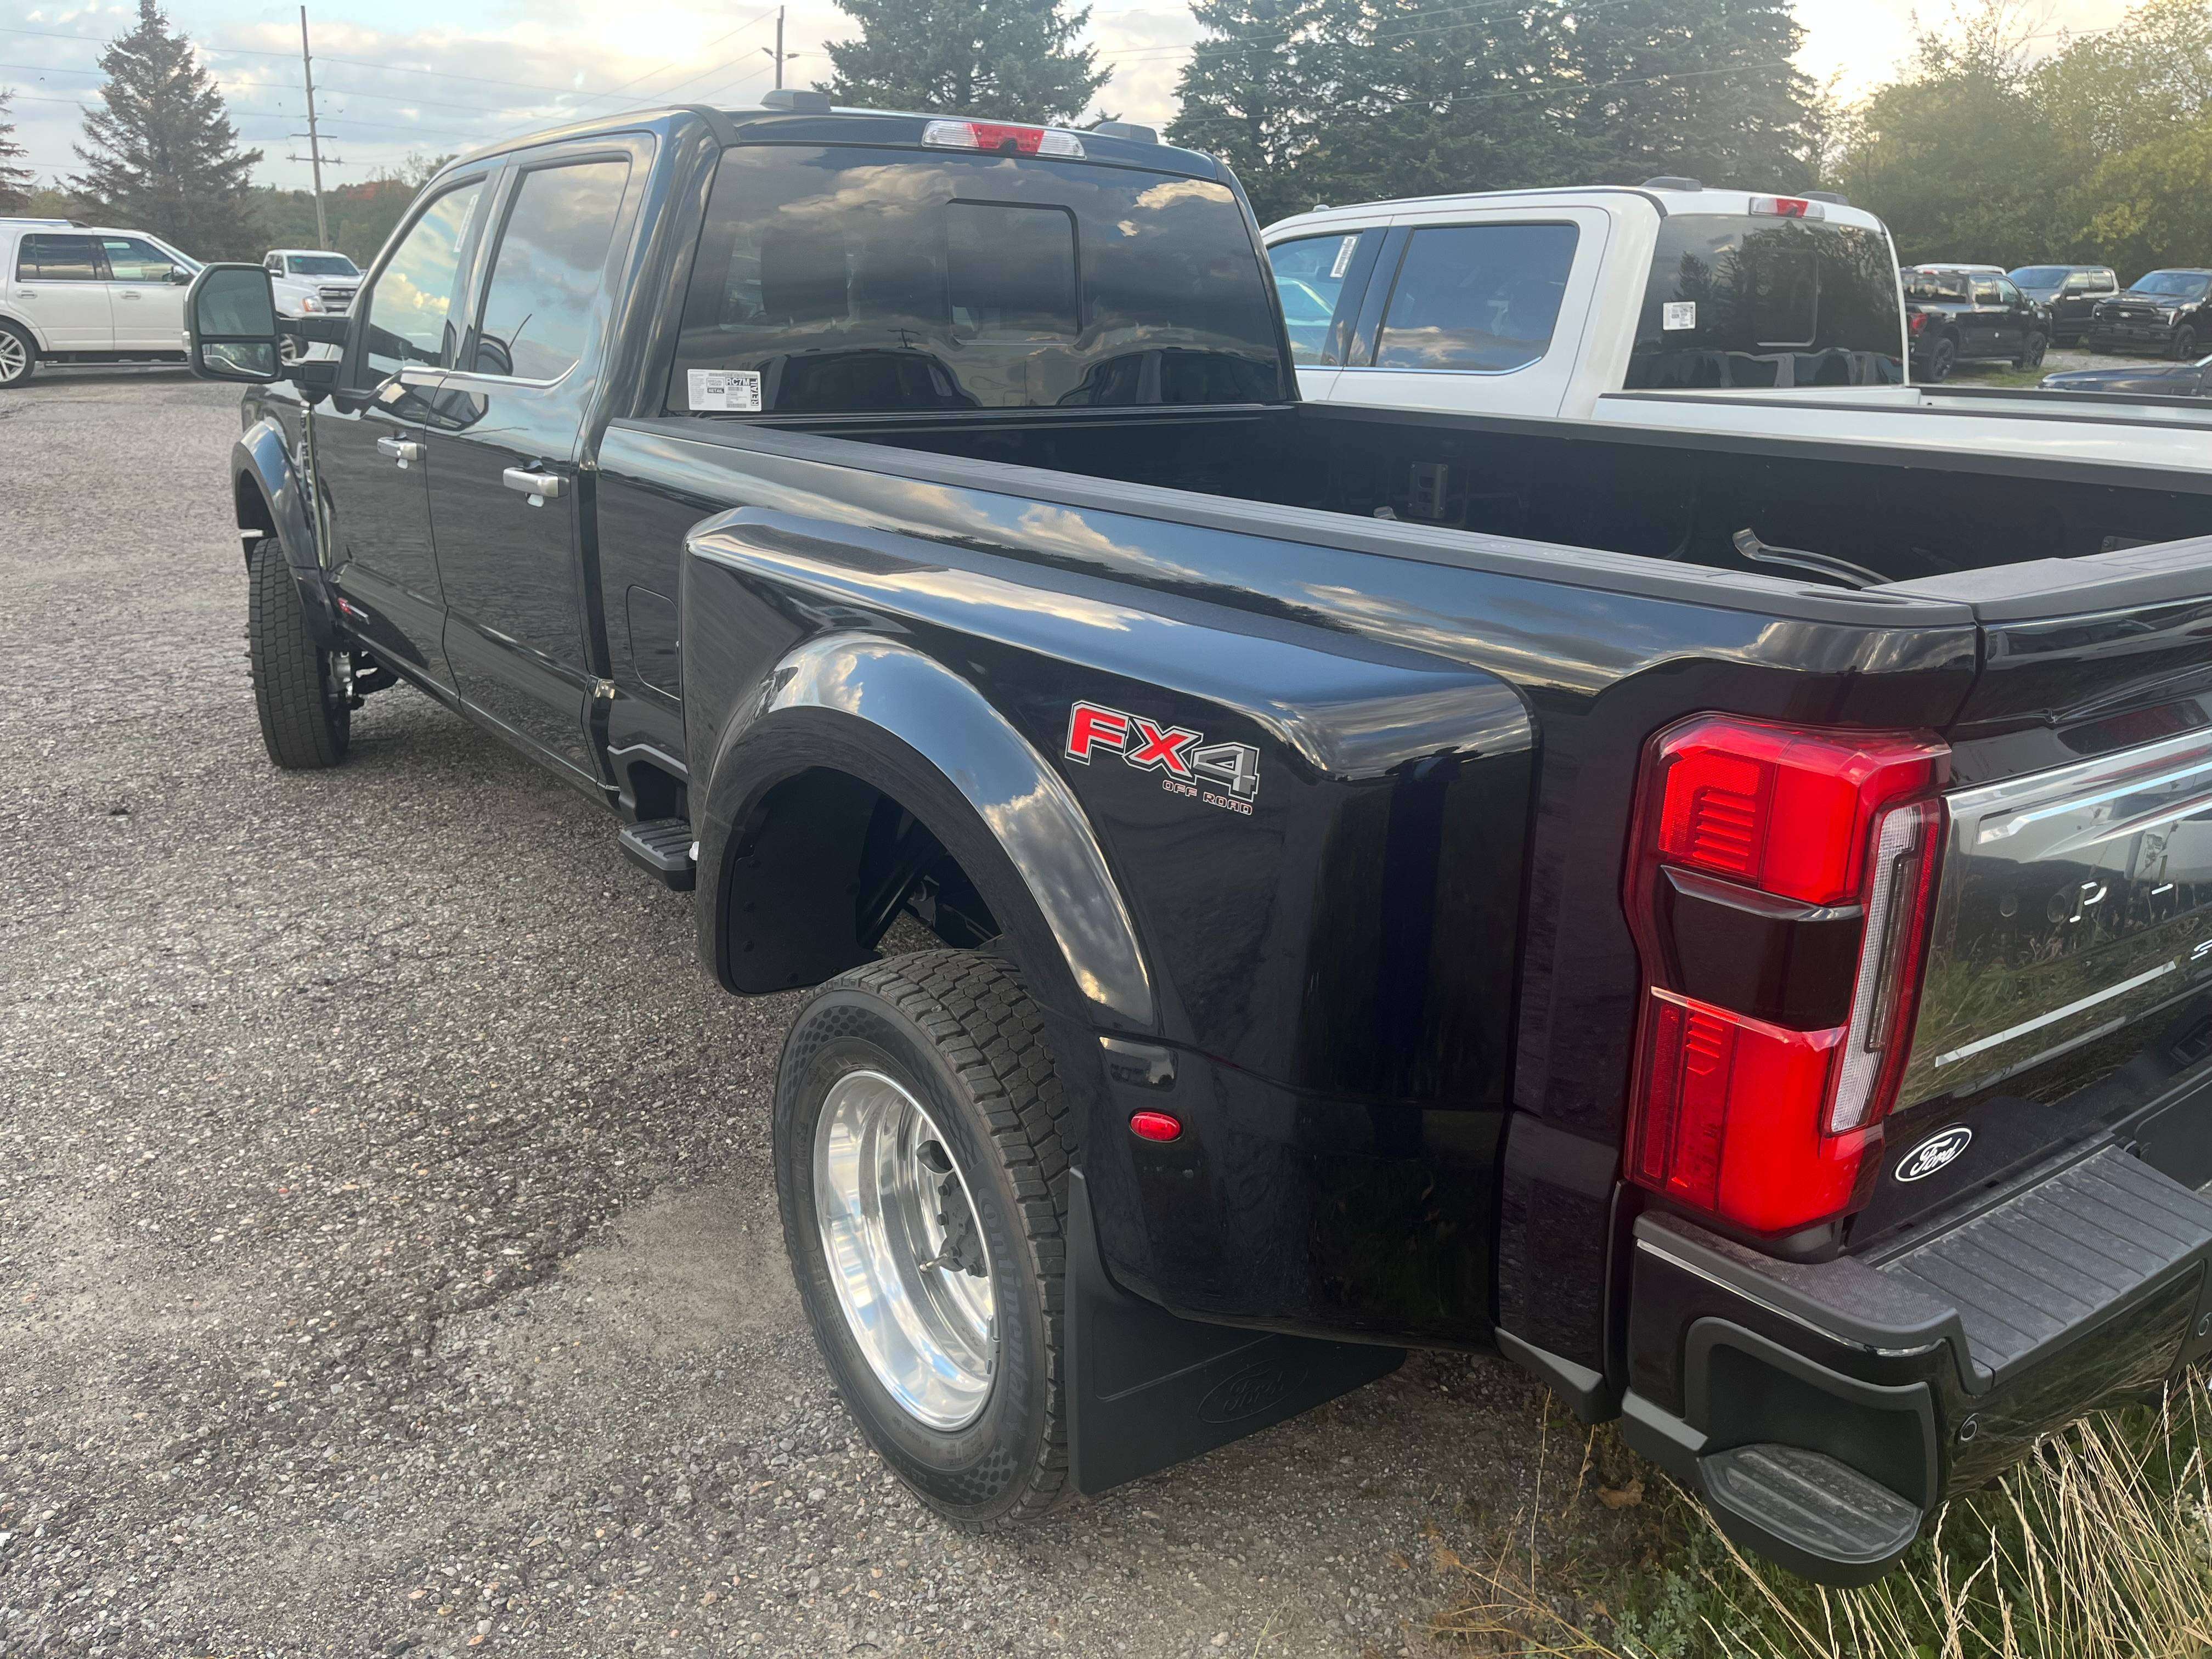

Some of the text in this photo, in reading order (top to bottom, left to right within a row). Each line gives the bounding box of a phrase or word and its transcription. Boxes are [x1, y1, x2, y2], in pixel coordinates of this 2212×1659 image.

[726, 377, 750, 386] RC7M
[750, 377, 758, 405] RETAIL
[1064, 700, 1260, 803] FX4
[1162, 780, 1253, 816] OFF ROAD
[1910, 1137, 1961, 1176] Ford
[975, 1188, 1029, 1417] Continental
[1223, 1369, 1285, 1412] Ford
